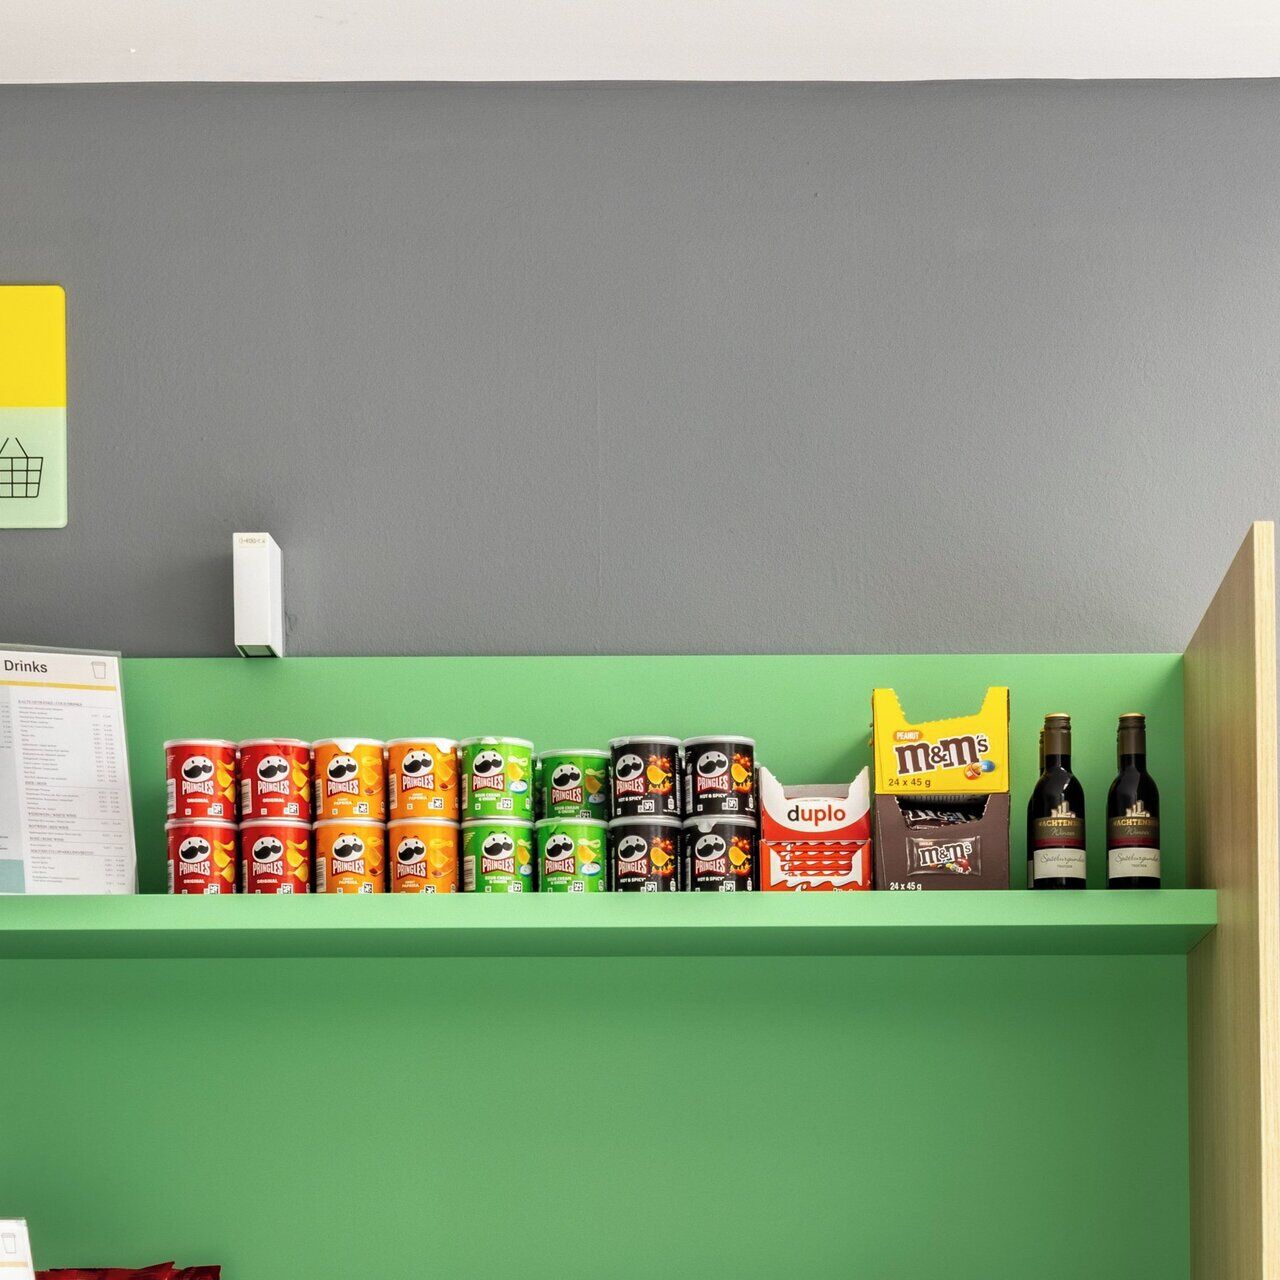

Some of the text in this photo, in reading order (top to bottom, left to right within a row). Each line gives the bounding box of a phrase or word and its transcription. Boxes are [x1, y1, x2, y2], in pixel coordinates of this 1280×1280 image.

[4, 659, 48, 673] Drinks
[896, 731, 920, 741] PEANUT
[182, 781, 214, 795] PRINGLES
[258, 781, 290, 795] PRINGLES
[328, 781, 359, 796] PRINGLES
[402, 775, 434, 791] PRINGLES
[472, 775, 504, 791] PRINGLES
[616, 777, 644, 793] PRINGLES
[697, 775, 728, 791] PRINGLES
[888, 778, 900, 786] 24
[910, 778, 922, 786] 45
[924, 780, 931, 788] g
[552, 789, 581, 803] PRINGLES
[787, 805, 846, 827] duplo
[179, 861, 211, 876] PRINGLES
[252, 861, 283, 876] PRINGLES
[333, 860, 364, 874] PRINGLES
[397, 862, 426, 877] PRINGLES
[482, 858, 515, 873] PRINGLES
[545, 860, 574, 874] PRINGLES
[618, 860, 646, 876] PRINGLES
[696, 859, 724, 875] PRINGLES
[890, 882, 899, 890] 24
[906, 882, 916, 890] 45
